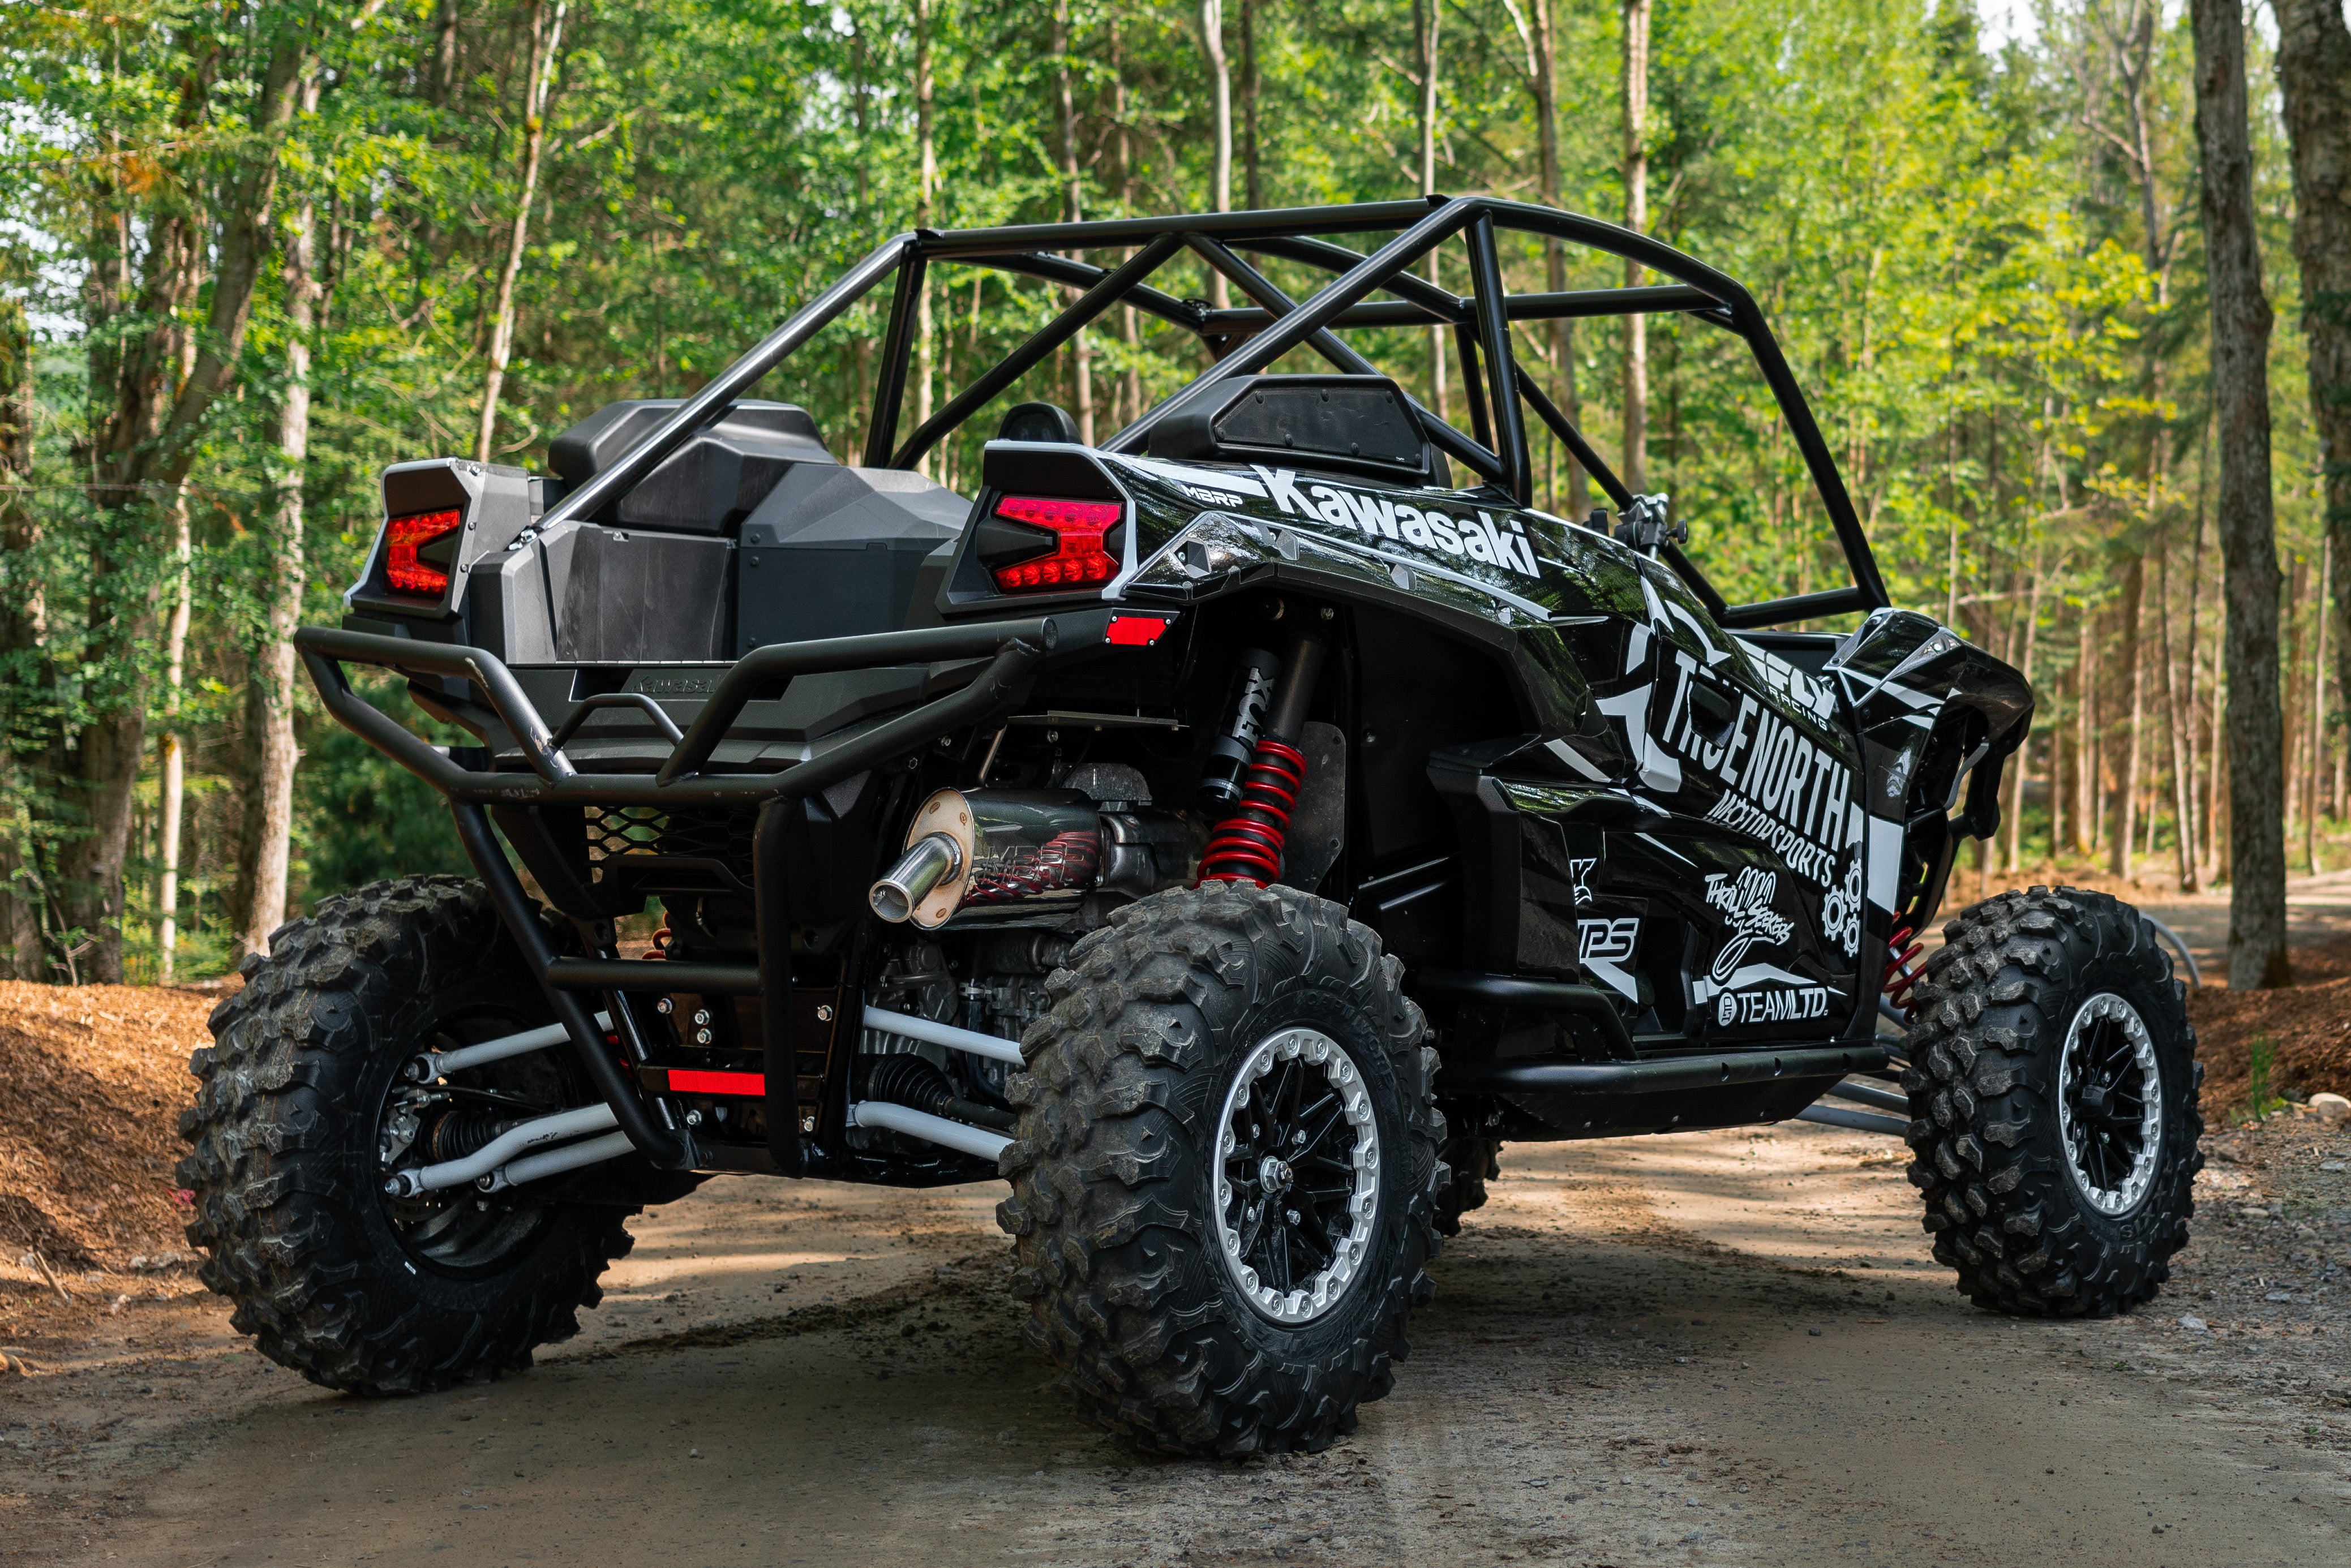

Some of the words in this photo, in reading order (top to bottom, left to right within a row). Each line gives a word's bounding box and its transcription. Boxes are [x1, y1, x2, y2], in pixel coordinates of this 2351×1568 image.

[1180, 484, 1243, 508] MBRP
[1250, 463, 1541, 579] Kawasaki
[628, 675, 721, 694] Kawasa
[1232, 667, 1276, 748] FOX
[1767, 685, 1827, 731] RACING
[1702, 788, 1836, 887] MOTORSPORTS
